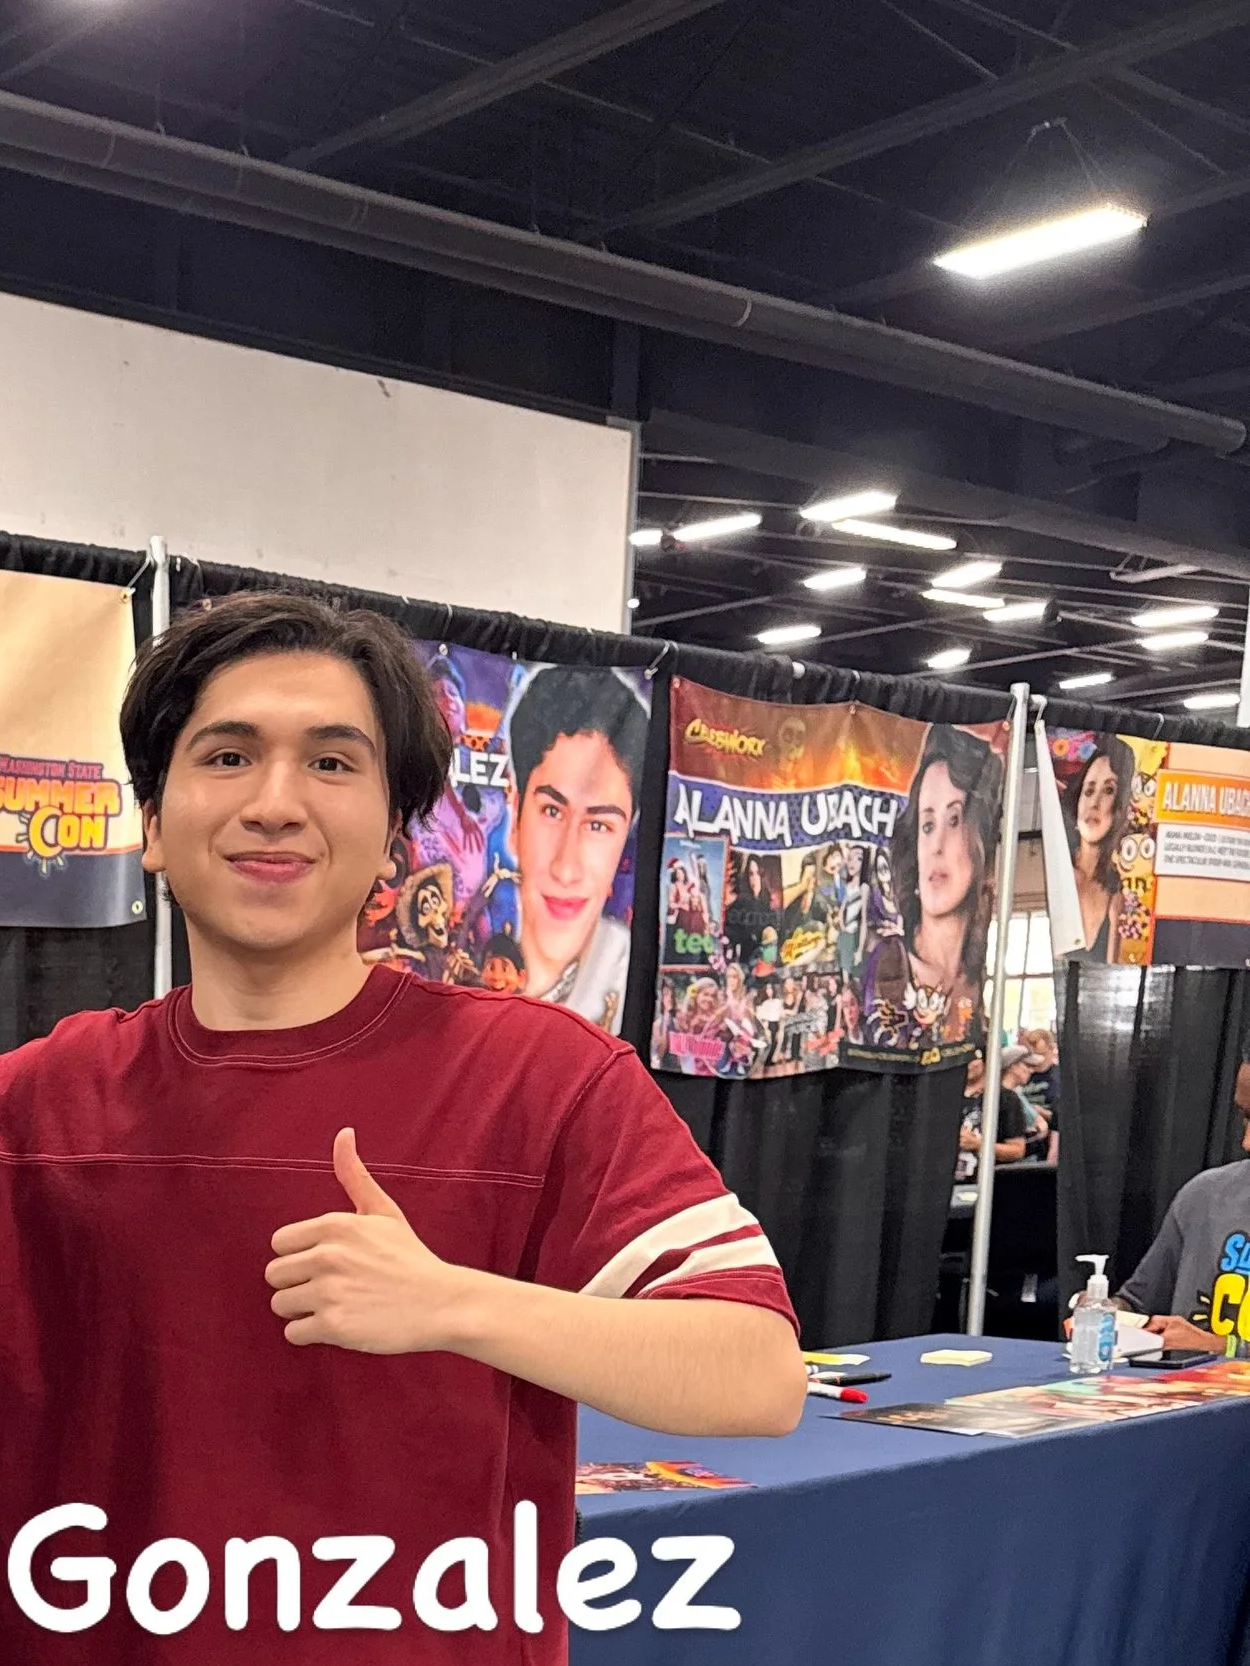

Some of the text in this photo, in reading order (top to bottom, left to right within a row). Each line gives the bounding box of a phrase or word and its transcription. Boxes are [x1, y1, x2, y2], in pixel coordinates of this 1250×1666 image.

[449, 748, 509, 787] LEZ
[674, 783, 898, 847] ALANNA UBACH
[1162, 781, 1216, 813] ALANNA
[29, 806, 106, 858] CON
